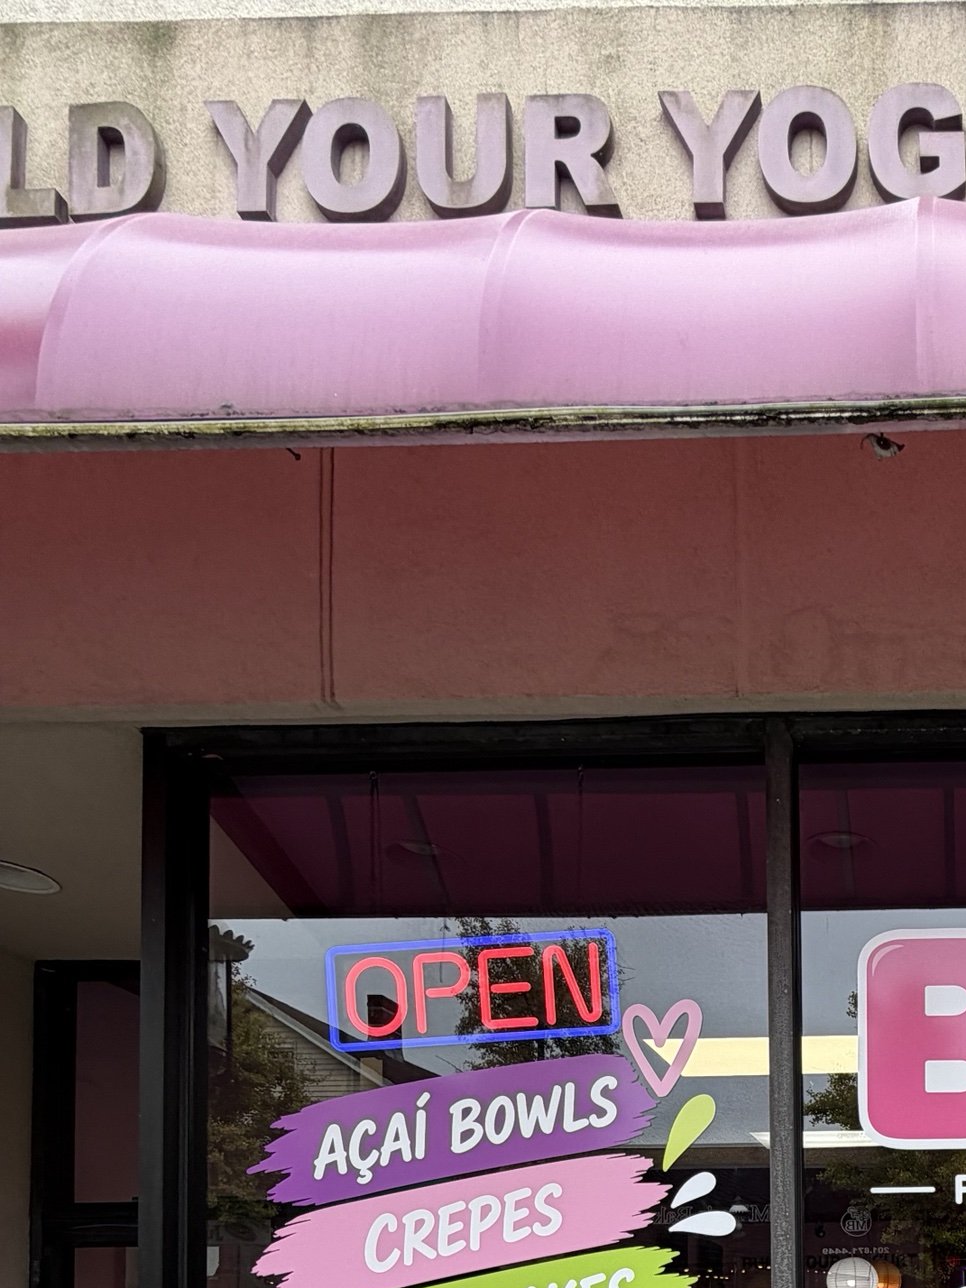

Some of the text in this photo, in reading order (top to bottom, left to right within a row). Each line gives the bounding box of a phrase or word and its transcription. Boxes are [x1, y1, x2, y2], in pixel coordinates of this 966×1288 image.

[203, 92, 622, 222] YOUR
[344, 941, 604, 1037] OPEN
[314, 1075, 617, 1185] AÇAÍ BOWLS
[364, 1183, 563, 1273] CREPES
